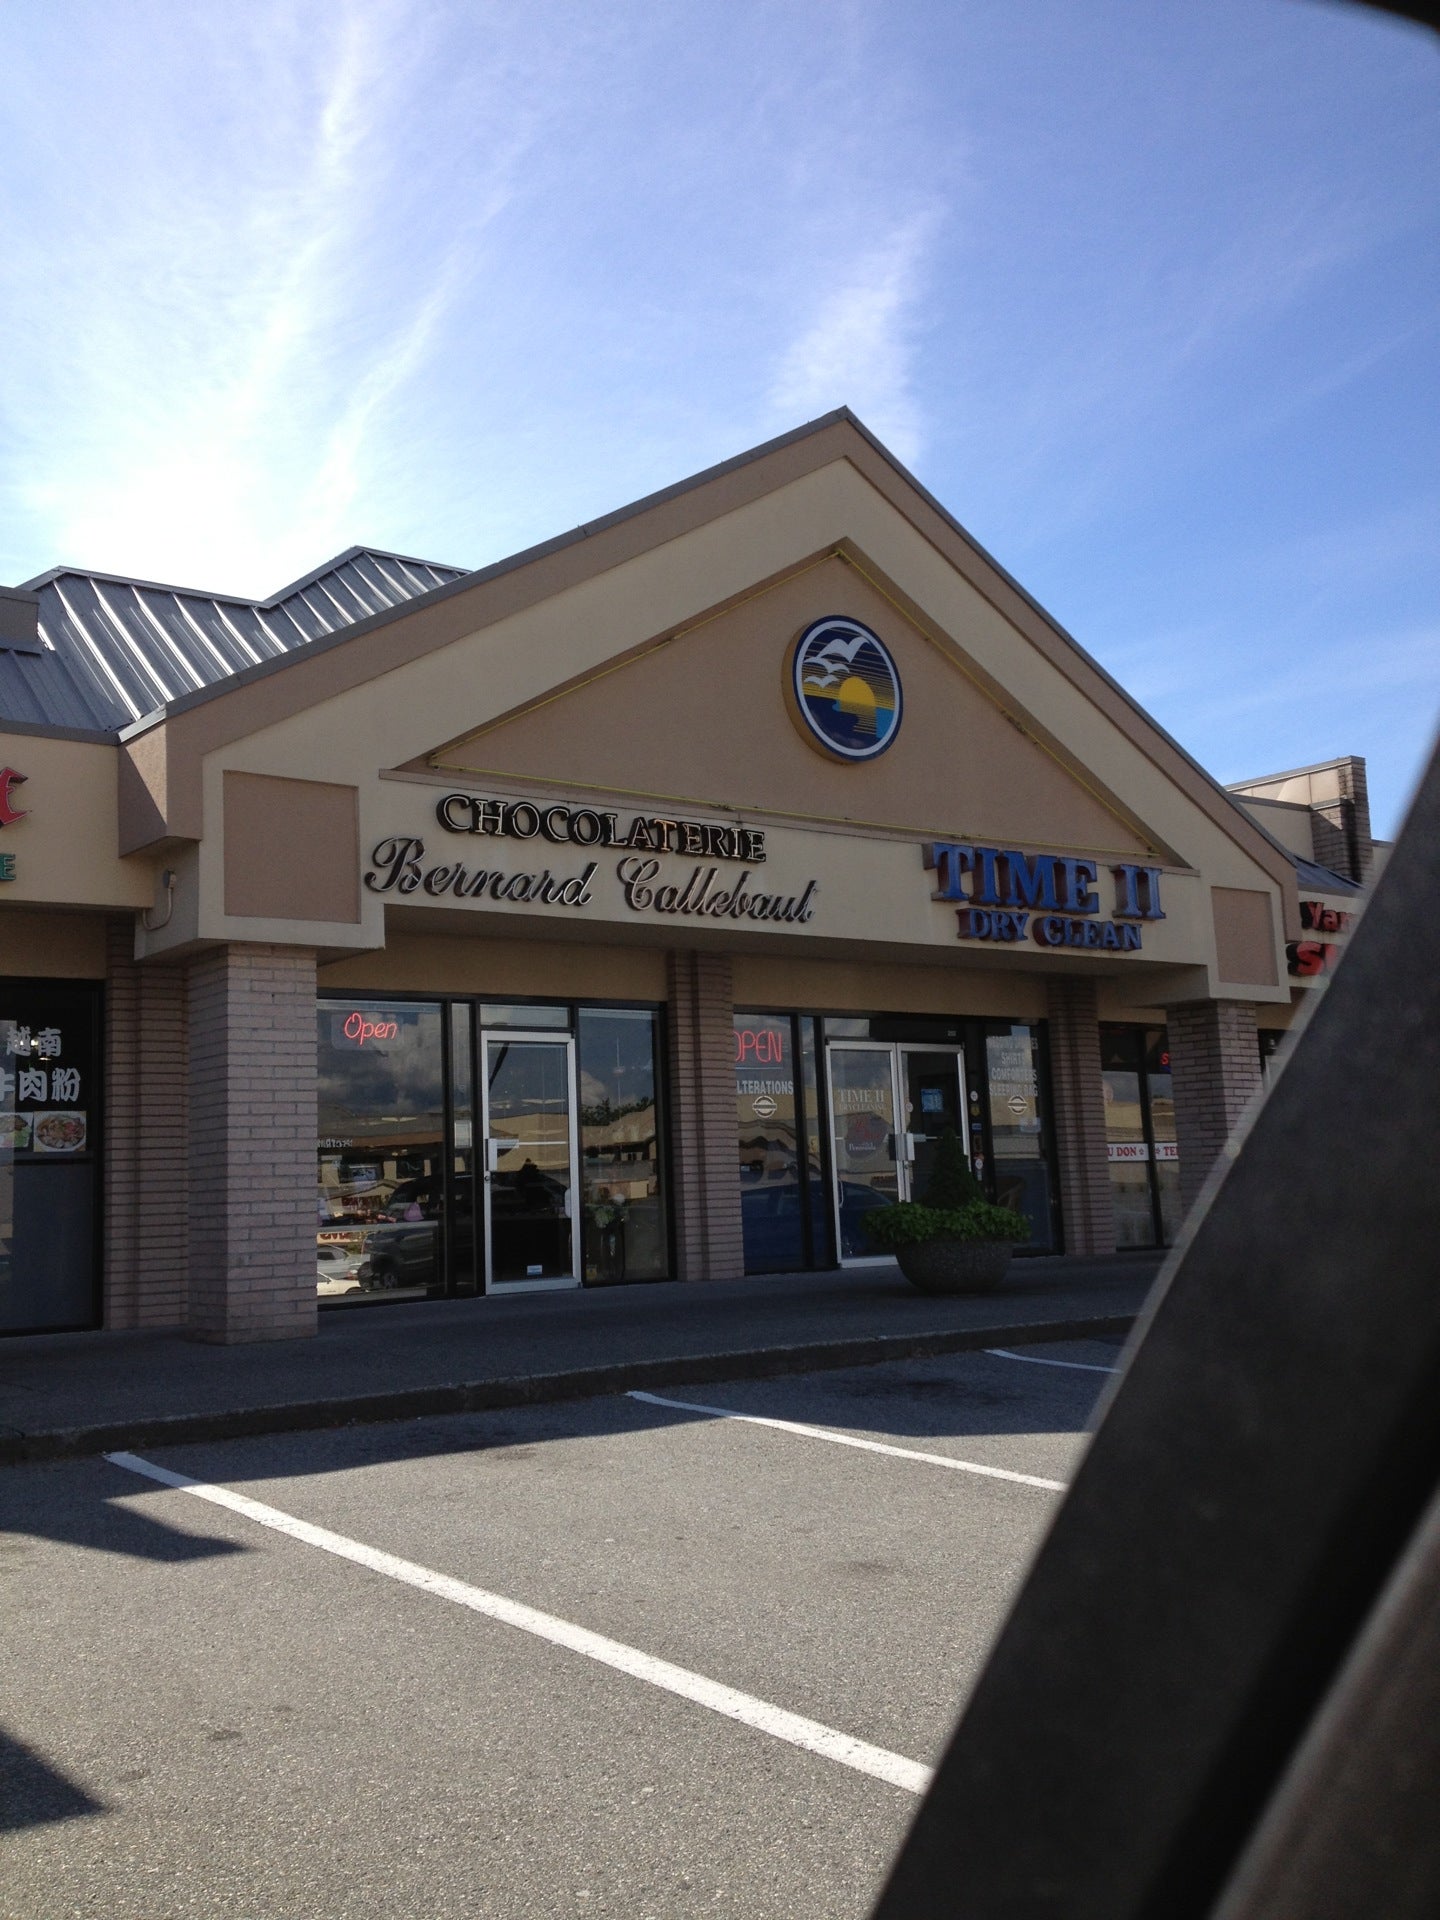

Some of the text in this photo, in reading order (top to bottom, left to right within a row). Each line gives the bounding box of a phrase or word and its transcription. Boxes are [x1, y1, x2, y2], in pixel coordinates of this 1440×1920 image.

[437, 794, 766, 862] CHOCOLATERIE
[364, 837, 817, 923] Bernard Callebaut
[922, 841, 1166, 920] TIME II
[956, 907, 1143, 951] DRY CLEAN
[6, 1025, 62, 1057] 越南
[344, 1012, 397, 1046] Open
[736, 1079, 794, 1095] LTERATIONS
[1116, 1146, 1137, 1157] DON
